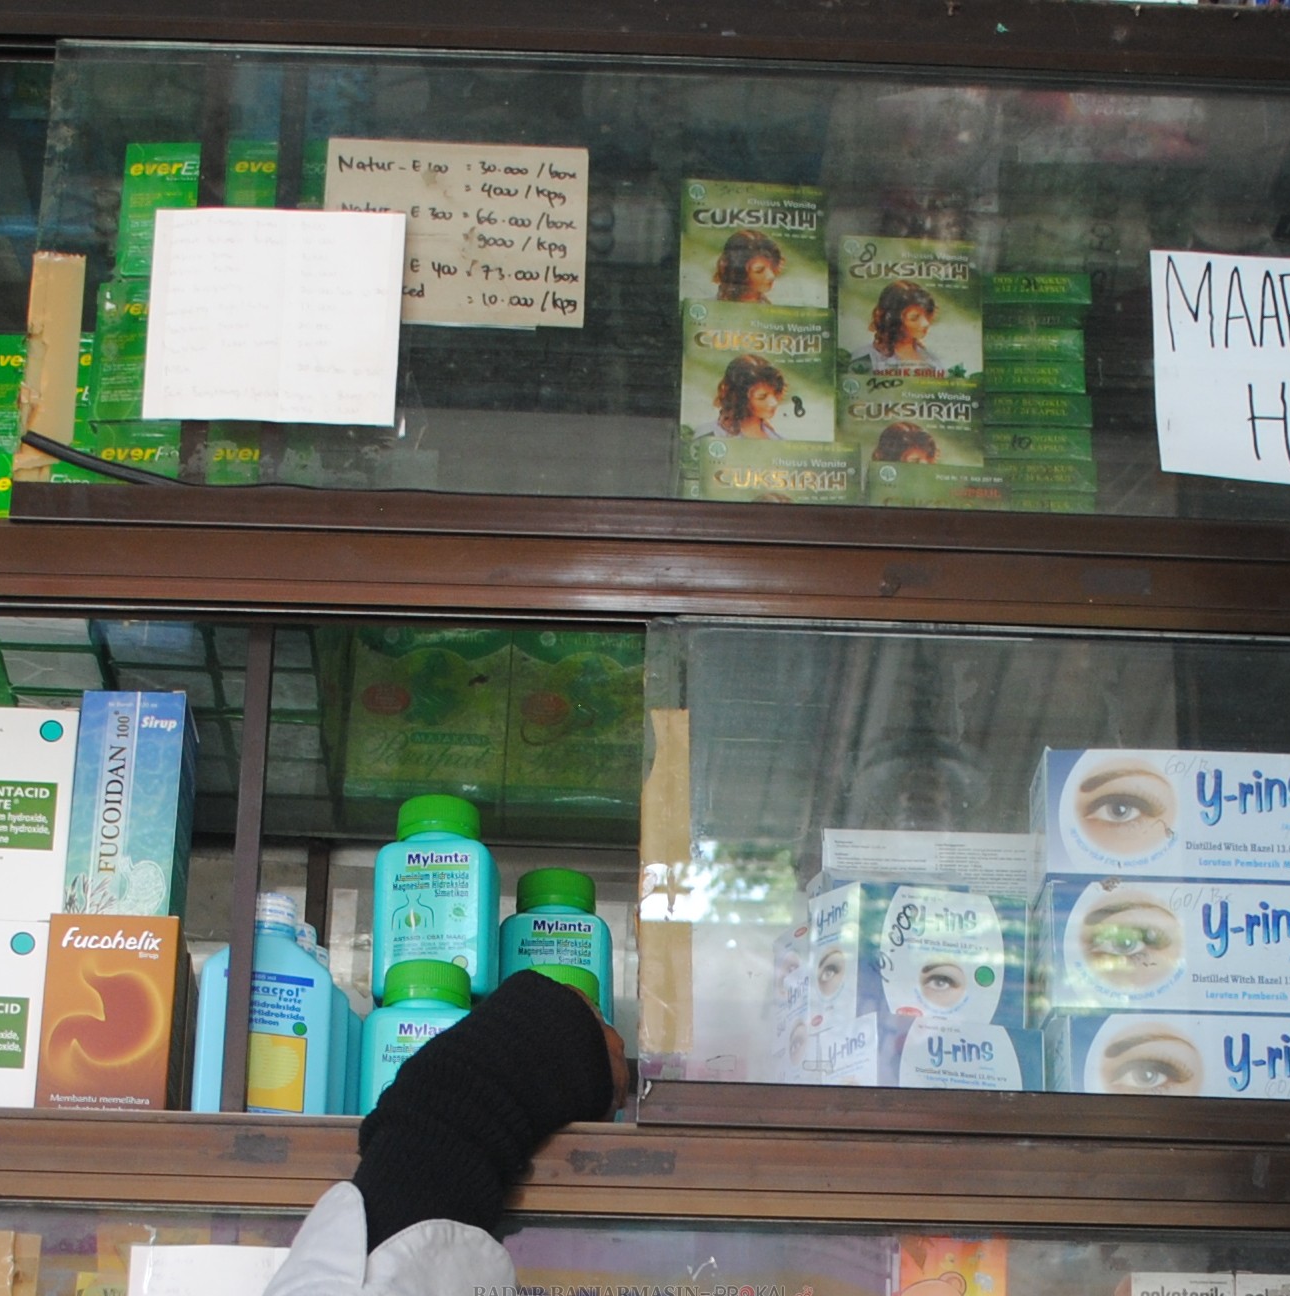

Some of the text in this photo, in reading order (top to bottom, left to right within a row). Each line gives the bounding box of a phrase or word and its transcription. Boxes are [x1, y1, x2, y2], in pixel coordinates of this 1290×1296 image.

[692, 208, 817, 230] CUKSIRIH
[848, 261, 969, 281] CUKSIRIH
[693, 331, 822, 355] CUKSIRIH
[141, 715, 177, 732] Sirup
[97, 745, 127, 874] FUCOIDAN
[407, 852, 470, 868] Mylanta
[532, 920, 592, 934] Mylanta
[61, 926, 162, 952] Fucohelix
